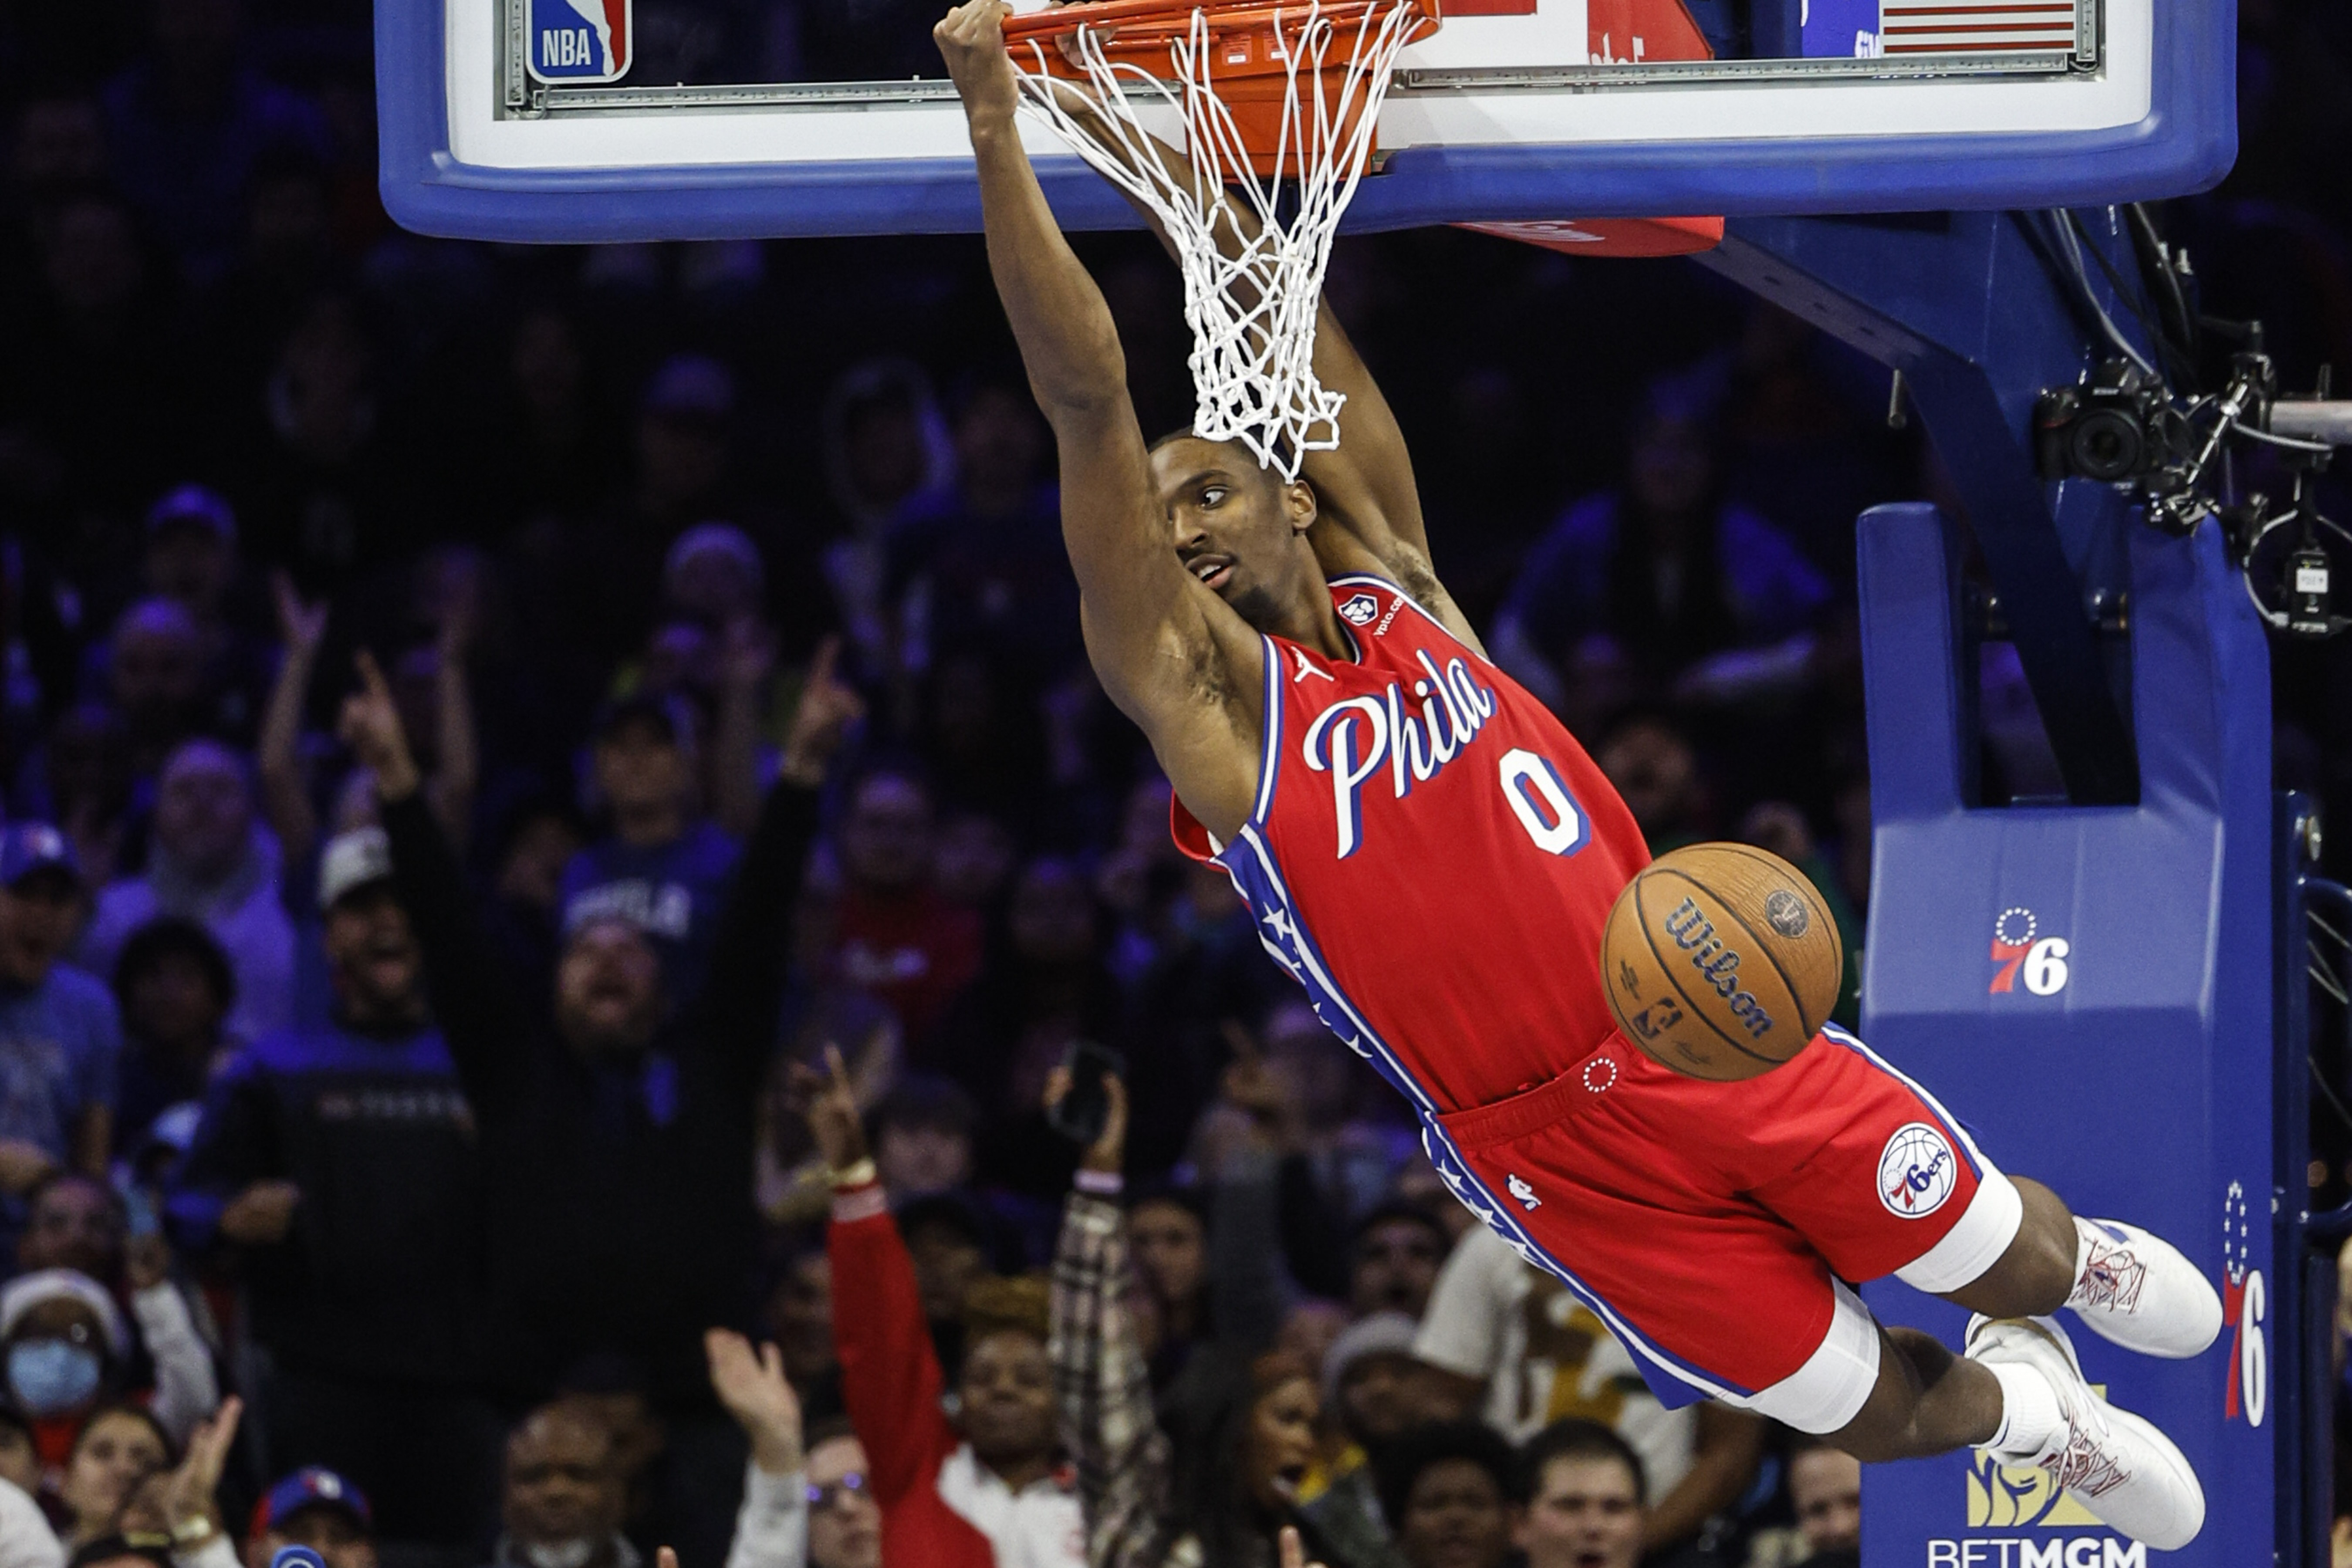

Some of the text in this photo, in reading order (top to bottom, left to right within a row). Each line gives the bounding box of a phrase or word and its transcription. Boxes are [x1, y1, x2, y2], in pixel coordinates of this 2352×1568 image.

[543, 28, 591, 67] NBA
[1303, 648, 1497, 859] Phila
[1499, 747, 1592, 857] 0
[1666, 896, 1774, 1040] Wilson
[1989, 936, 2070, 996] 76
[1890, 1148, 1948, 1211] 76ers
[2223, 1263, 2266, 1428] 76
